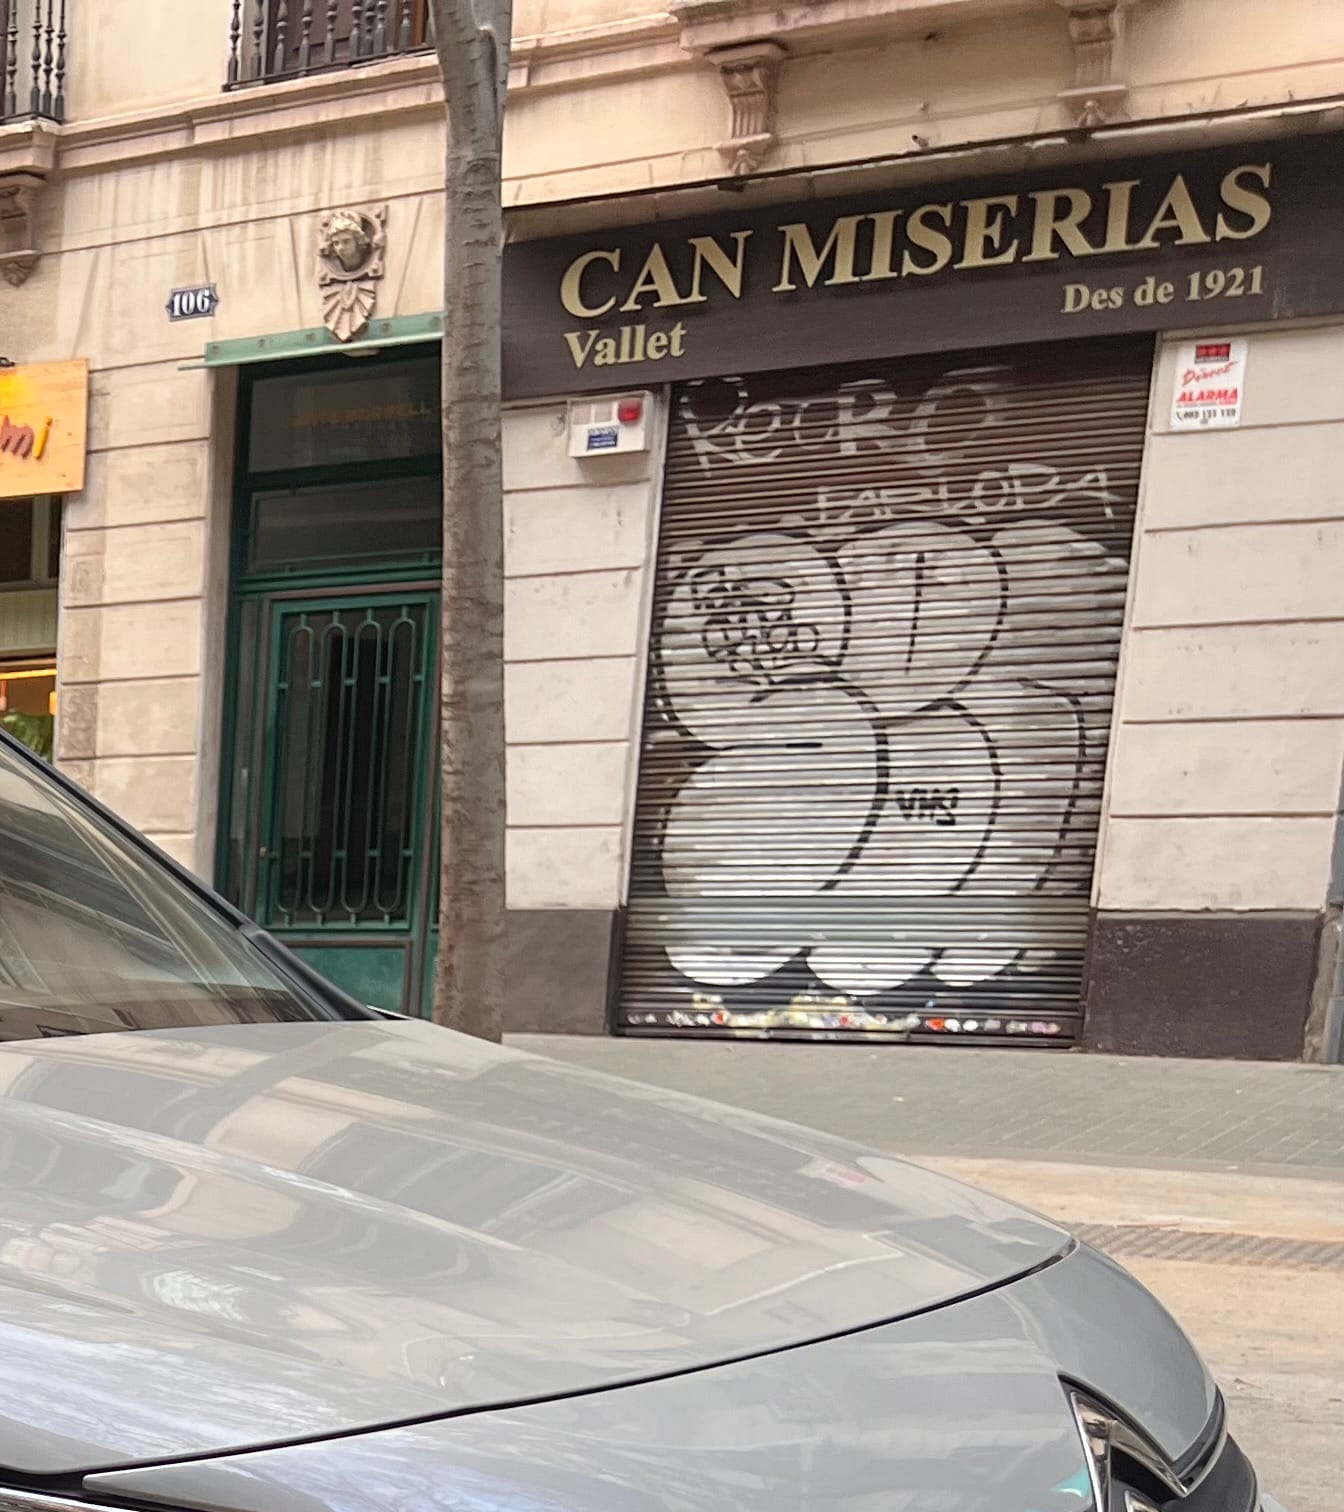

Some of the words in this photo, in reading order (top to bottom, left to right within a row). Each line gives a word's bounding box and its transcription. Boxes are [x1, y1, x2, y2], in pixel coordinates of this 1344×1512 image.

[559, 230, 753, 319] CAN
[771, 162, 1274, 293] MISERIAS
[173, 288, 210, 316] 106
[1061, 283, 1124, 314] Des
[1134, 277, 1175, 307] de
[1186, 266, 1264, 301] 1921
[564, 321, 686, 369] Vallet
[1177, 388, 1238, 404] ALARMA
